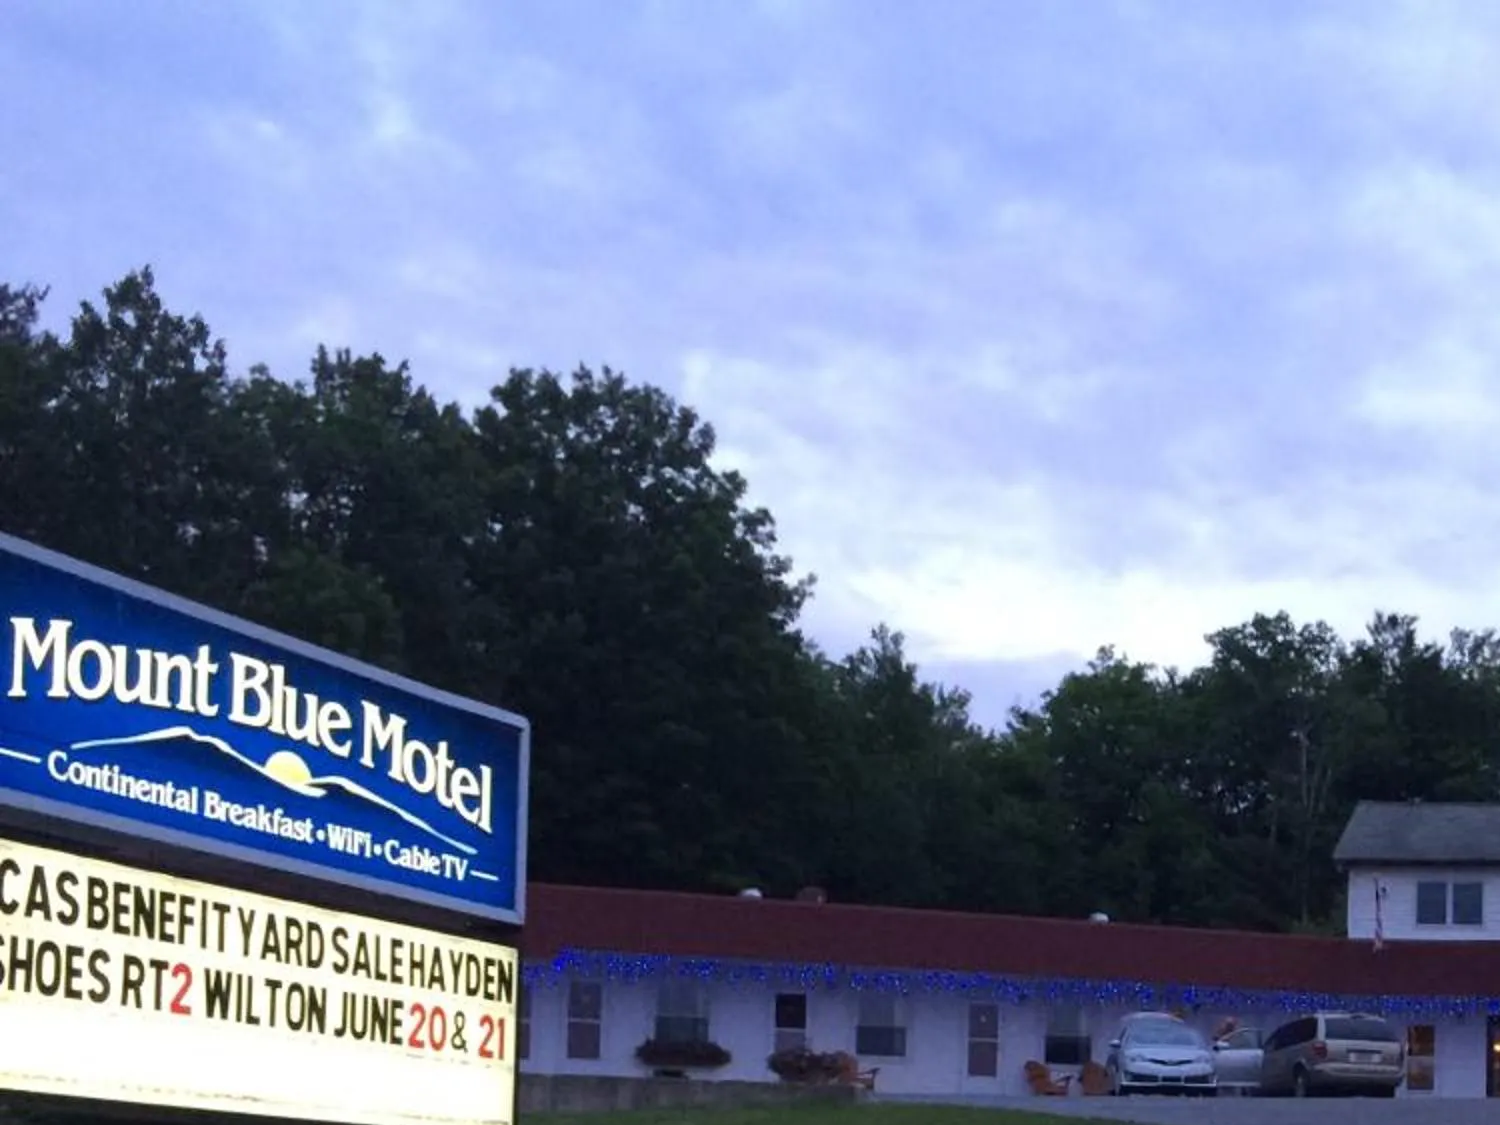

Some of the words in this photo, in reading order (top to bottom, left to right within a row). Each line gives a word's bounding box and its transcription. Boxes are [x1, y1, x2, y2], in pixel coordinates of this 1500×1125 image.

[7, 617, 218, 717] Mount
[229, 652, 353, 757] Blue
[360, 699, 493, 833] Motel
[47, 750, 198, 814] Continental
[204, 790, 314, 844] Breakfast
[383, 839, 441, 875] Cable
[442, 853, 469, 881] TV
[0, 933, 111, 1004] HOES
[204, 968, 327, 1035] WILTON
[334, 992, 404, 1046] JUNE
[408, 1003, 447, 1051] 20
[451, 1010, 469, 1053] &
[478, 1014, 506, 1061] 21
[87, 875, 231, 953] BENEFIT
[238, 906, 325, 969] YARD
[331, 926, 404, 984] SALE
[409, 941, 513, 1004] HAYDEN
